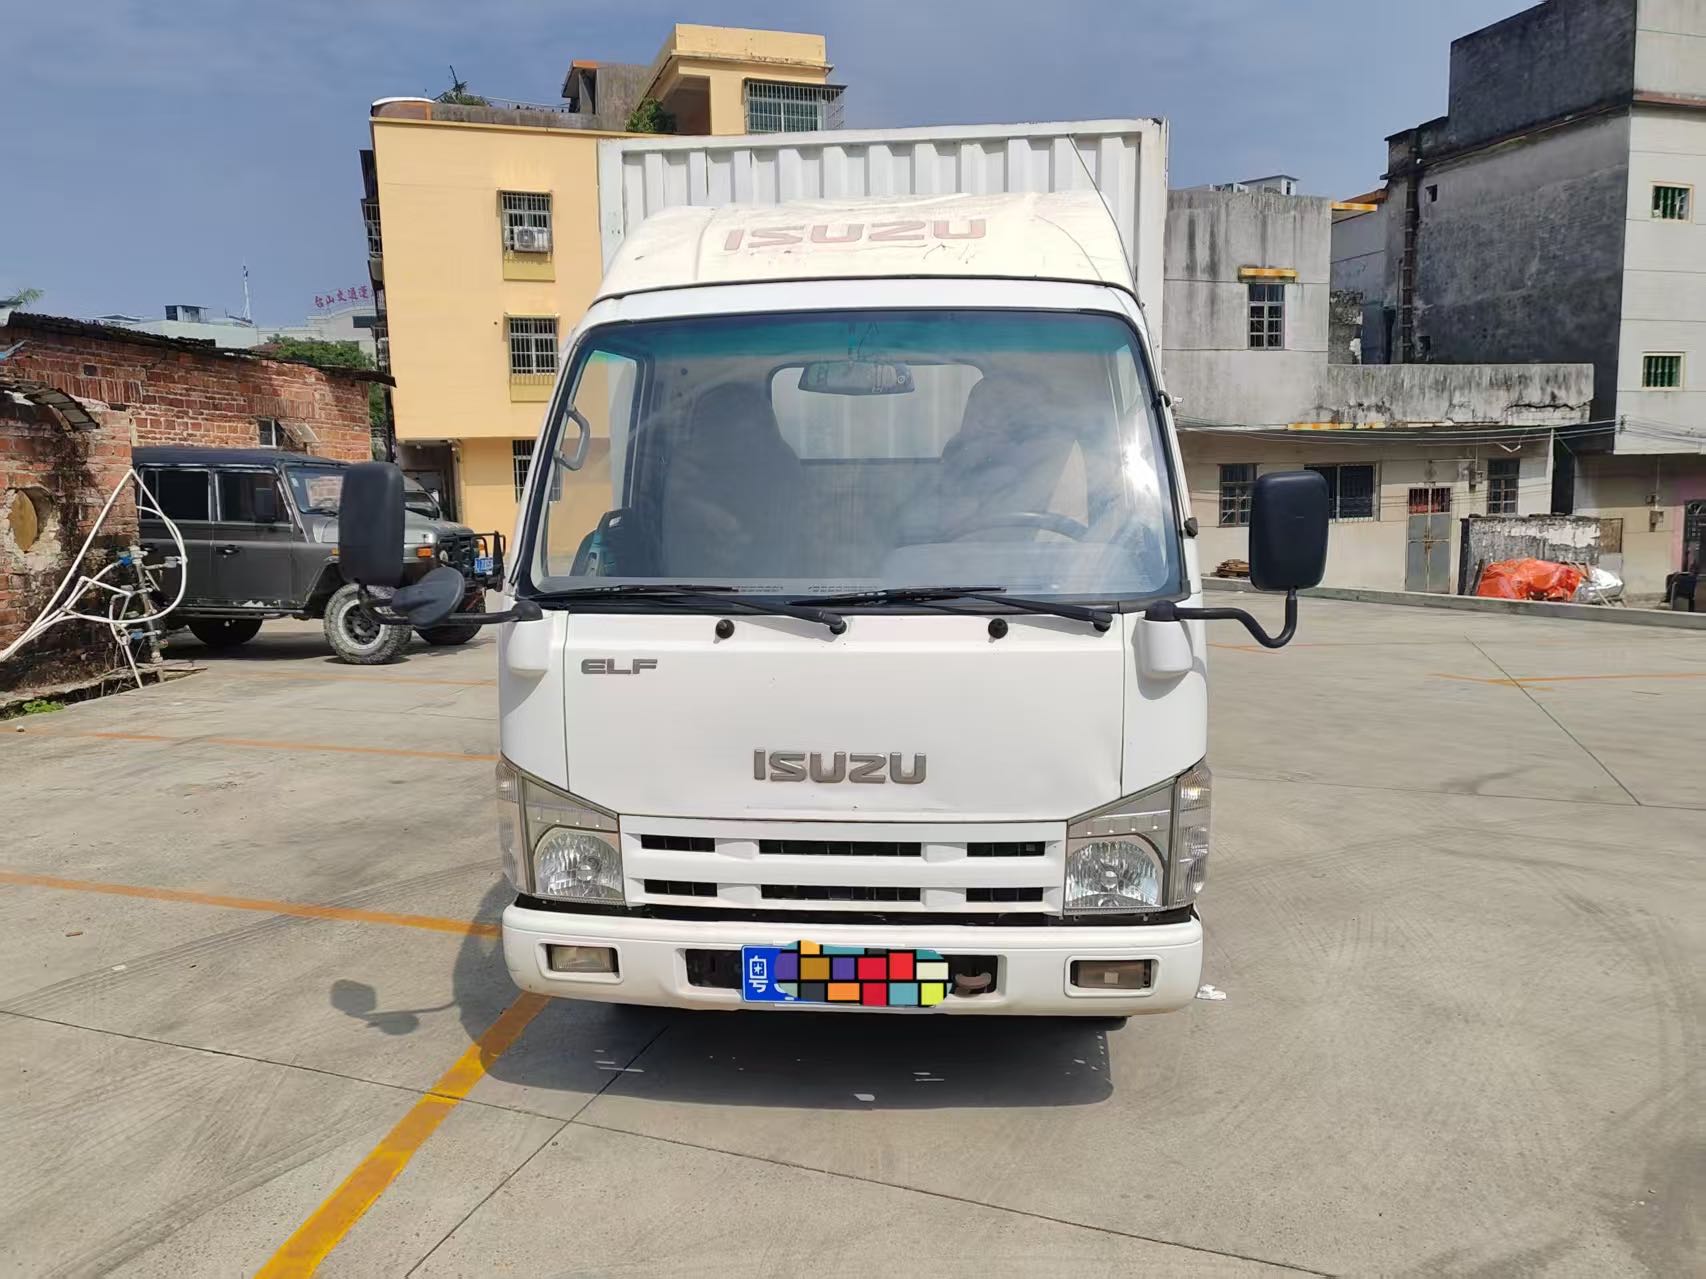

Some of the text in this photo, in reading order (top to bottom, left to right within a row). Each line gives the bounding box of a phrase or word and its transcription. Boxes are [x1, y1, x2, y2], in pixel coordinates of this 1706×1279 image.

[724, 219, 986, 251] ISUZU
[581, 658, 658, 675] ELF
[753, 749, 927, 784] ISUZU
